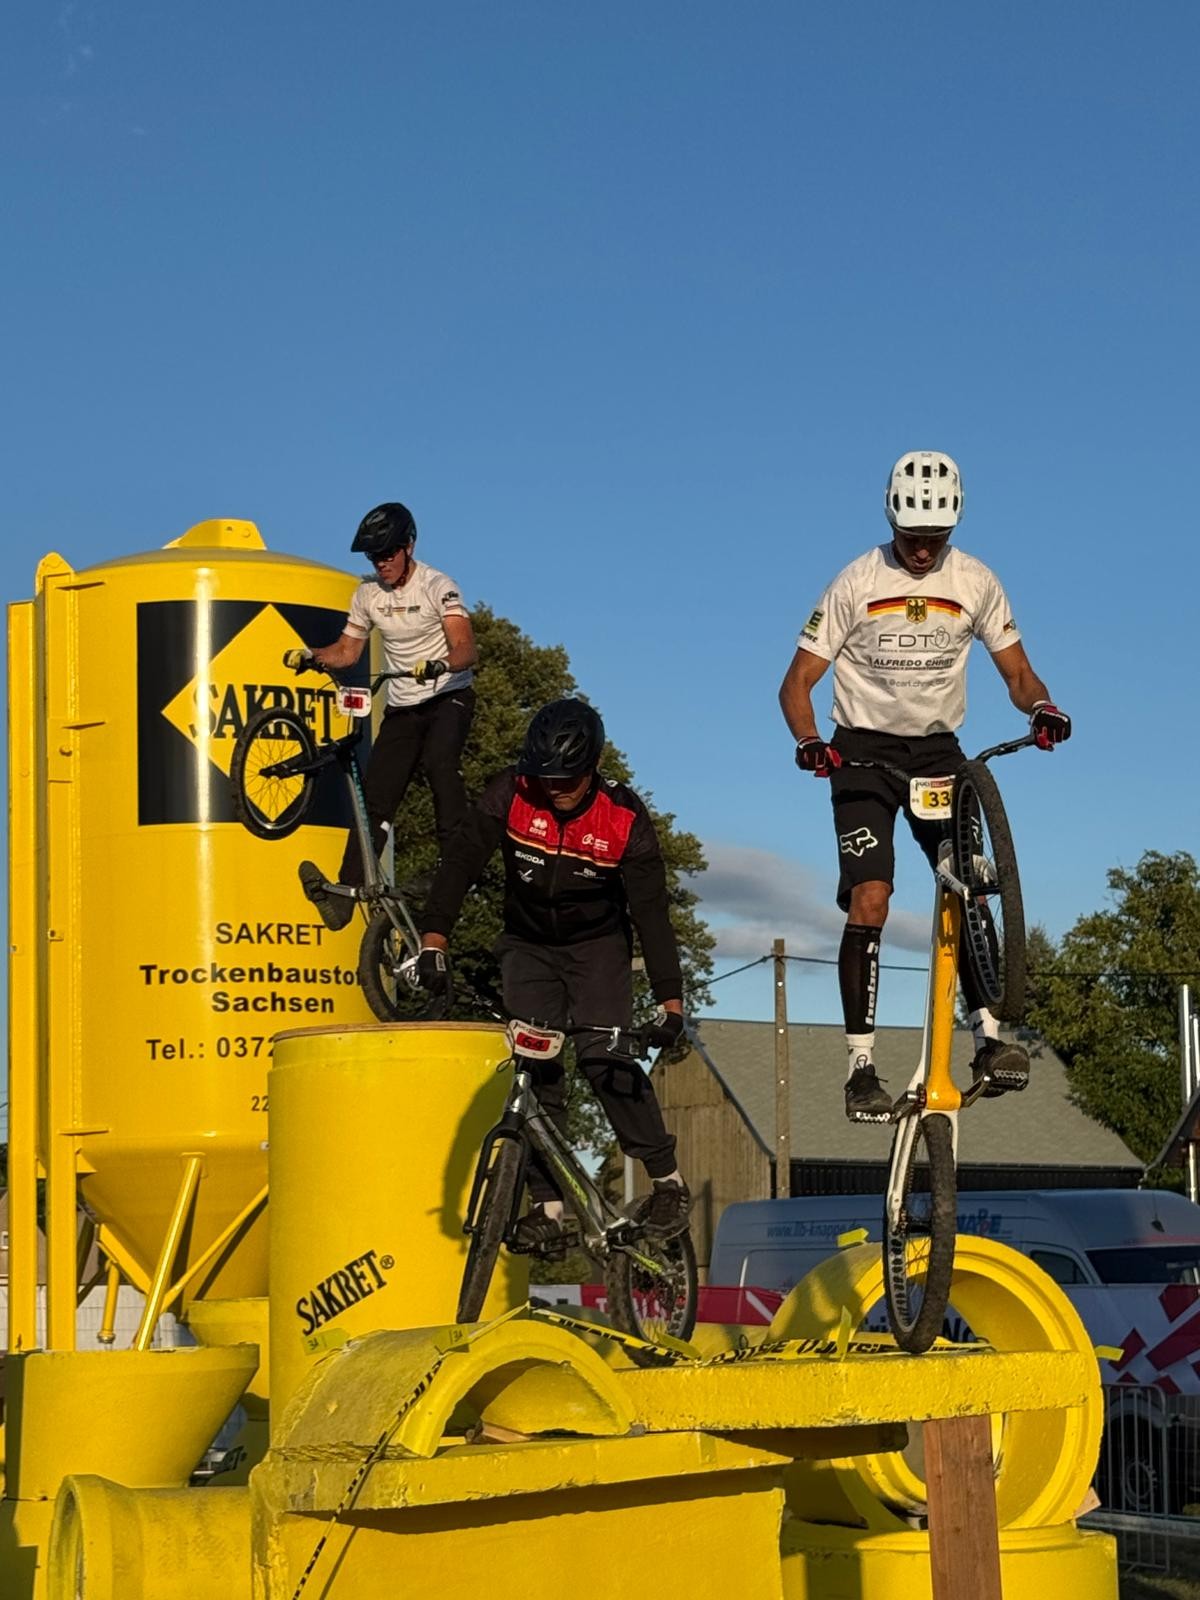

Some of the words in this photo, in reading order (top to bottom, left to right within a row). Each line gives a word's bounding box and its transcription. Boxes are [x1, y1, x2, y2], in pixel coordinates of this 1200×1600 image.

[873, 658, 922, 667] ALFREDO
[928, 791, 951, 808] 33
[215, 922, 326, 946] SAKRET
[211, 991, 335, 1013] Sachsen
[145, 1038, 205, 1060] Tel.:
